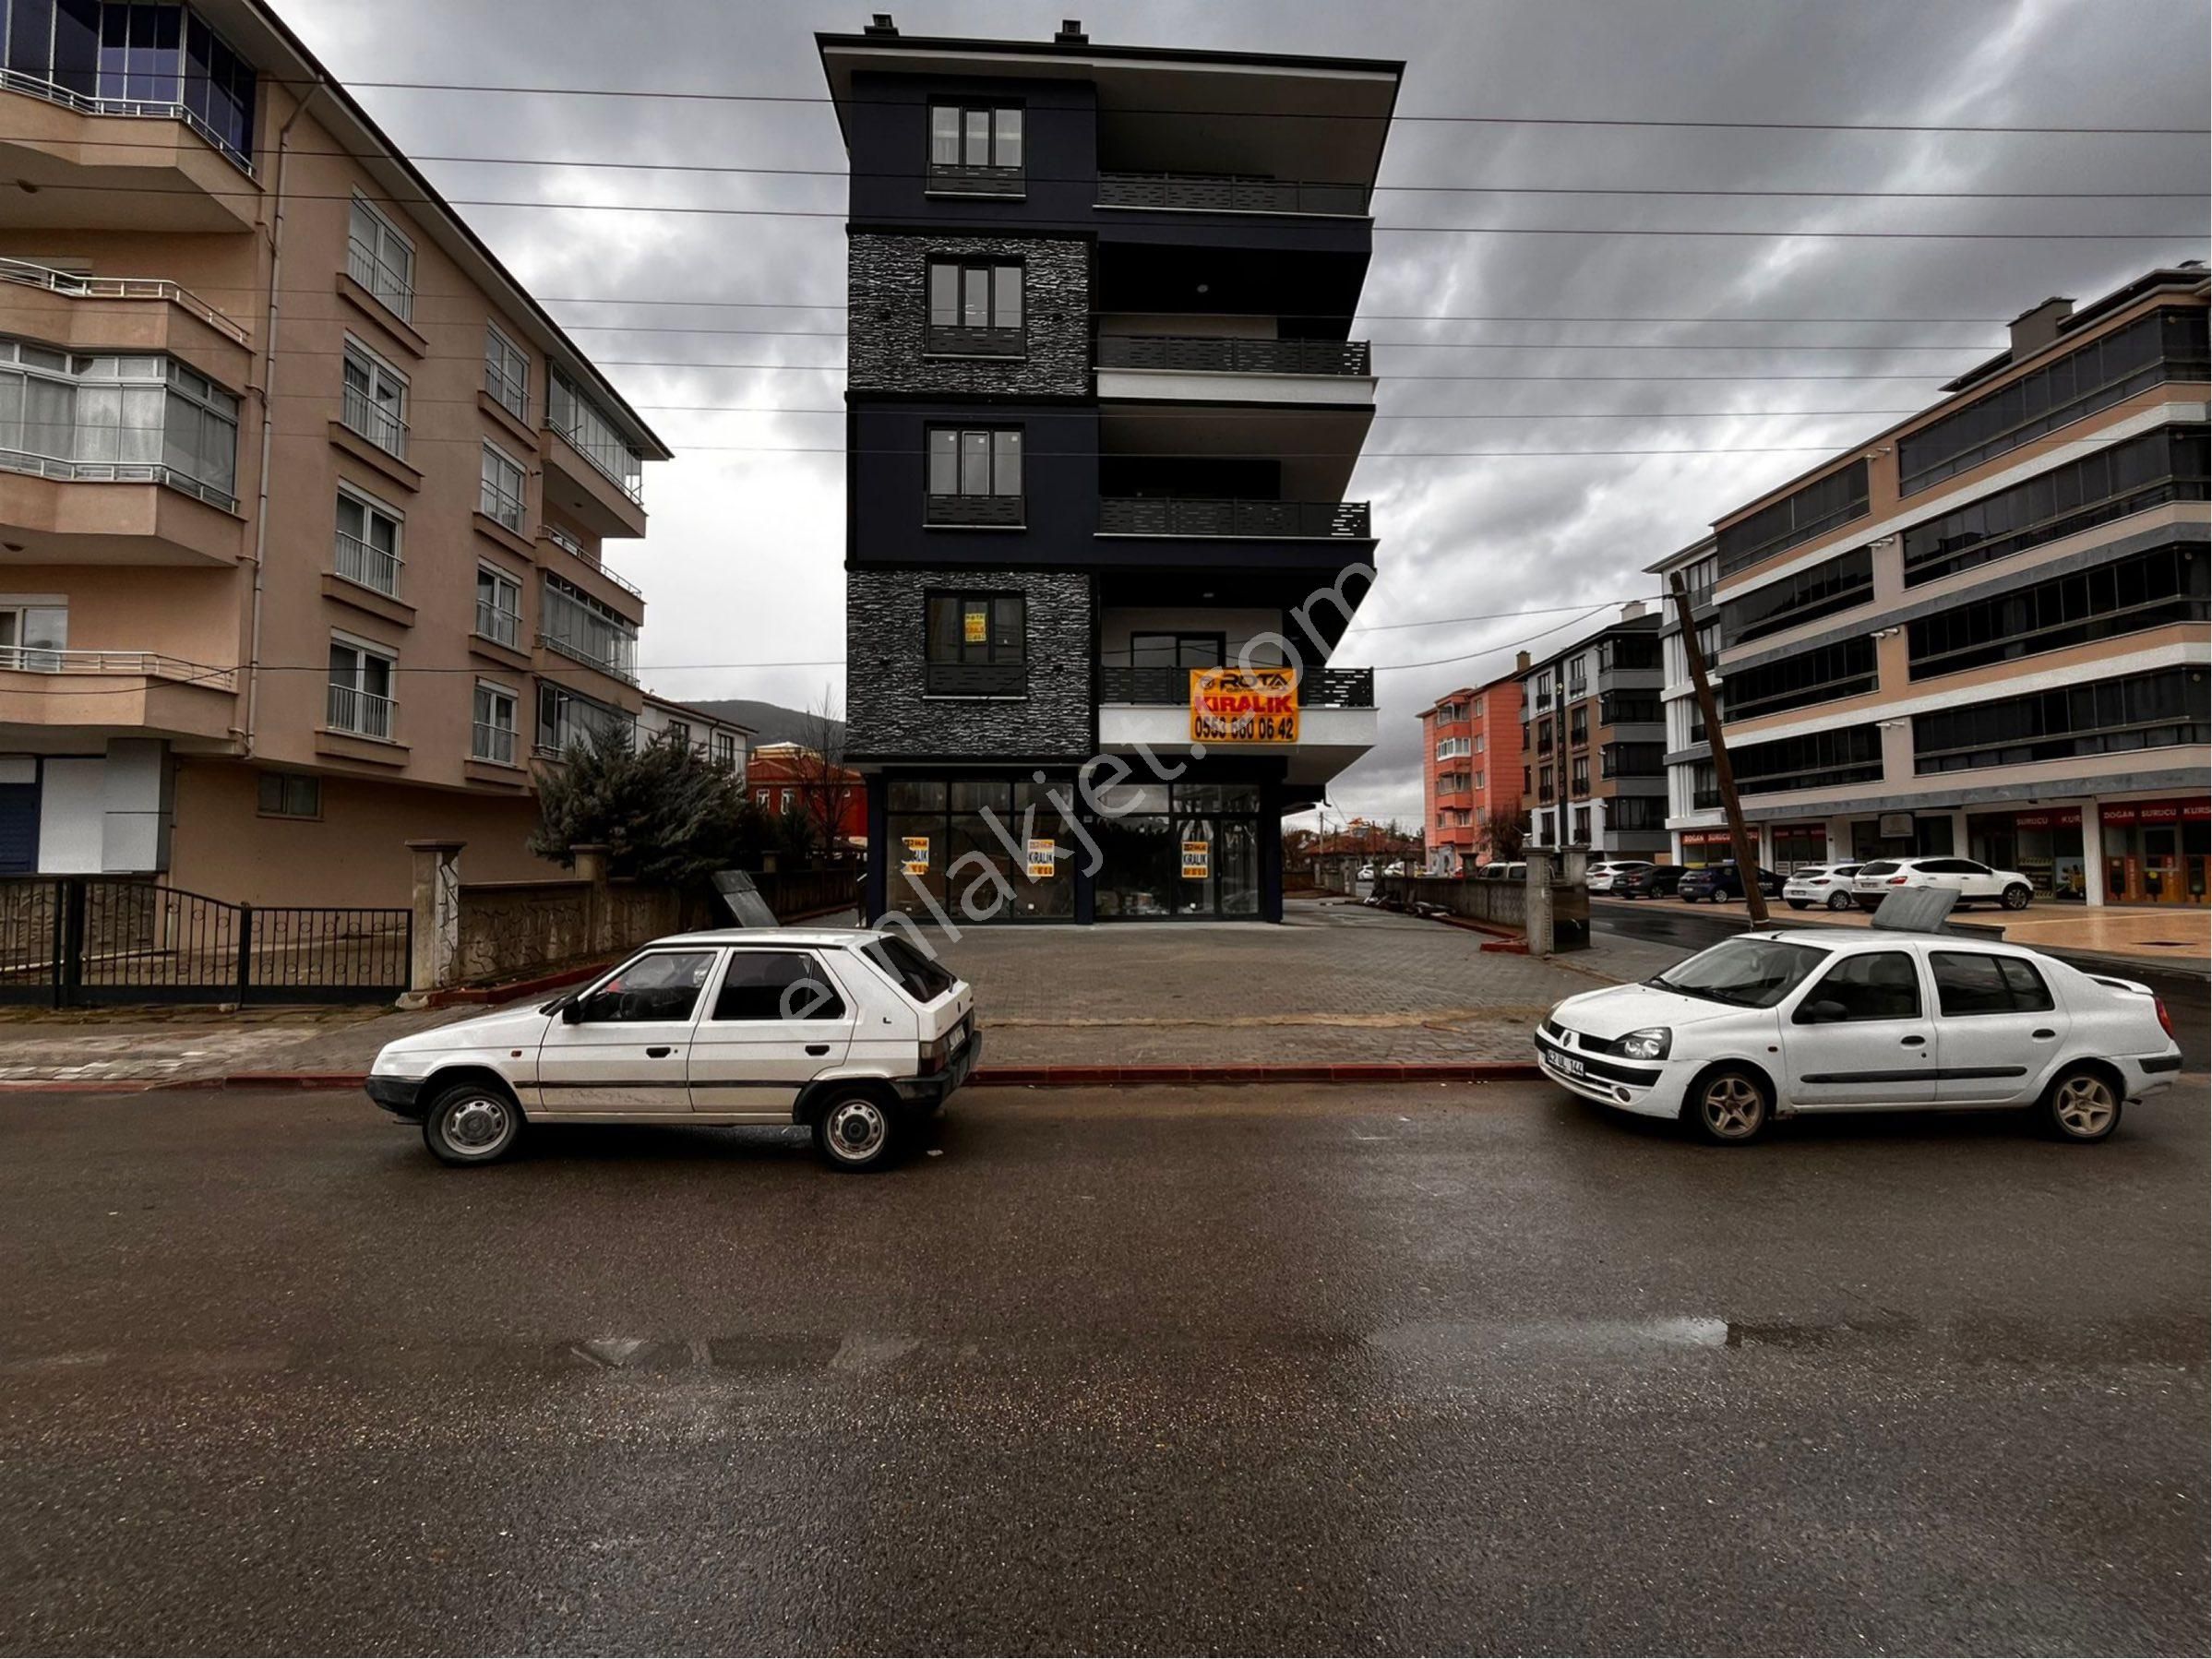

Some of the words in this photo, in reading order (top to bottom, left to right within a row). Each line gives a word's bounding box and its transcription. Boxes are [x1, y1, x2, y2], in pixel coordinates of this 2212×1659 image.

[1195, 696, 1293, 713] KIRALIK
[1259, 717, 1274, 739] 06
[1278, 717, 1294, 739] 42
